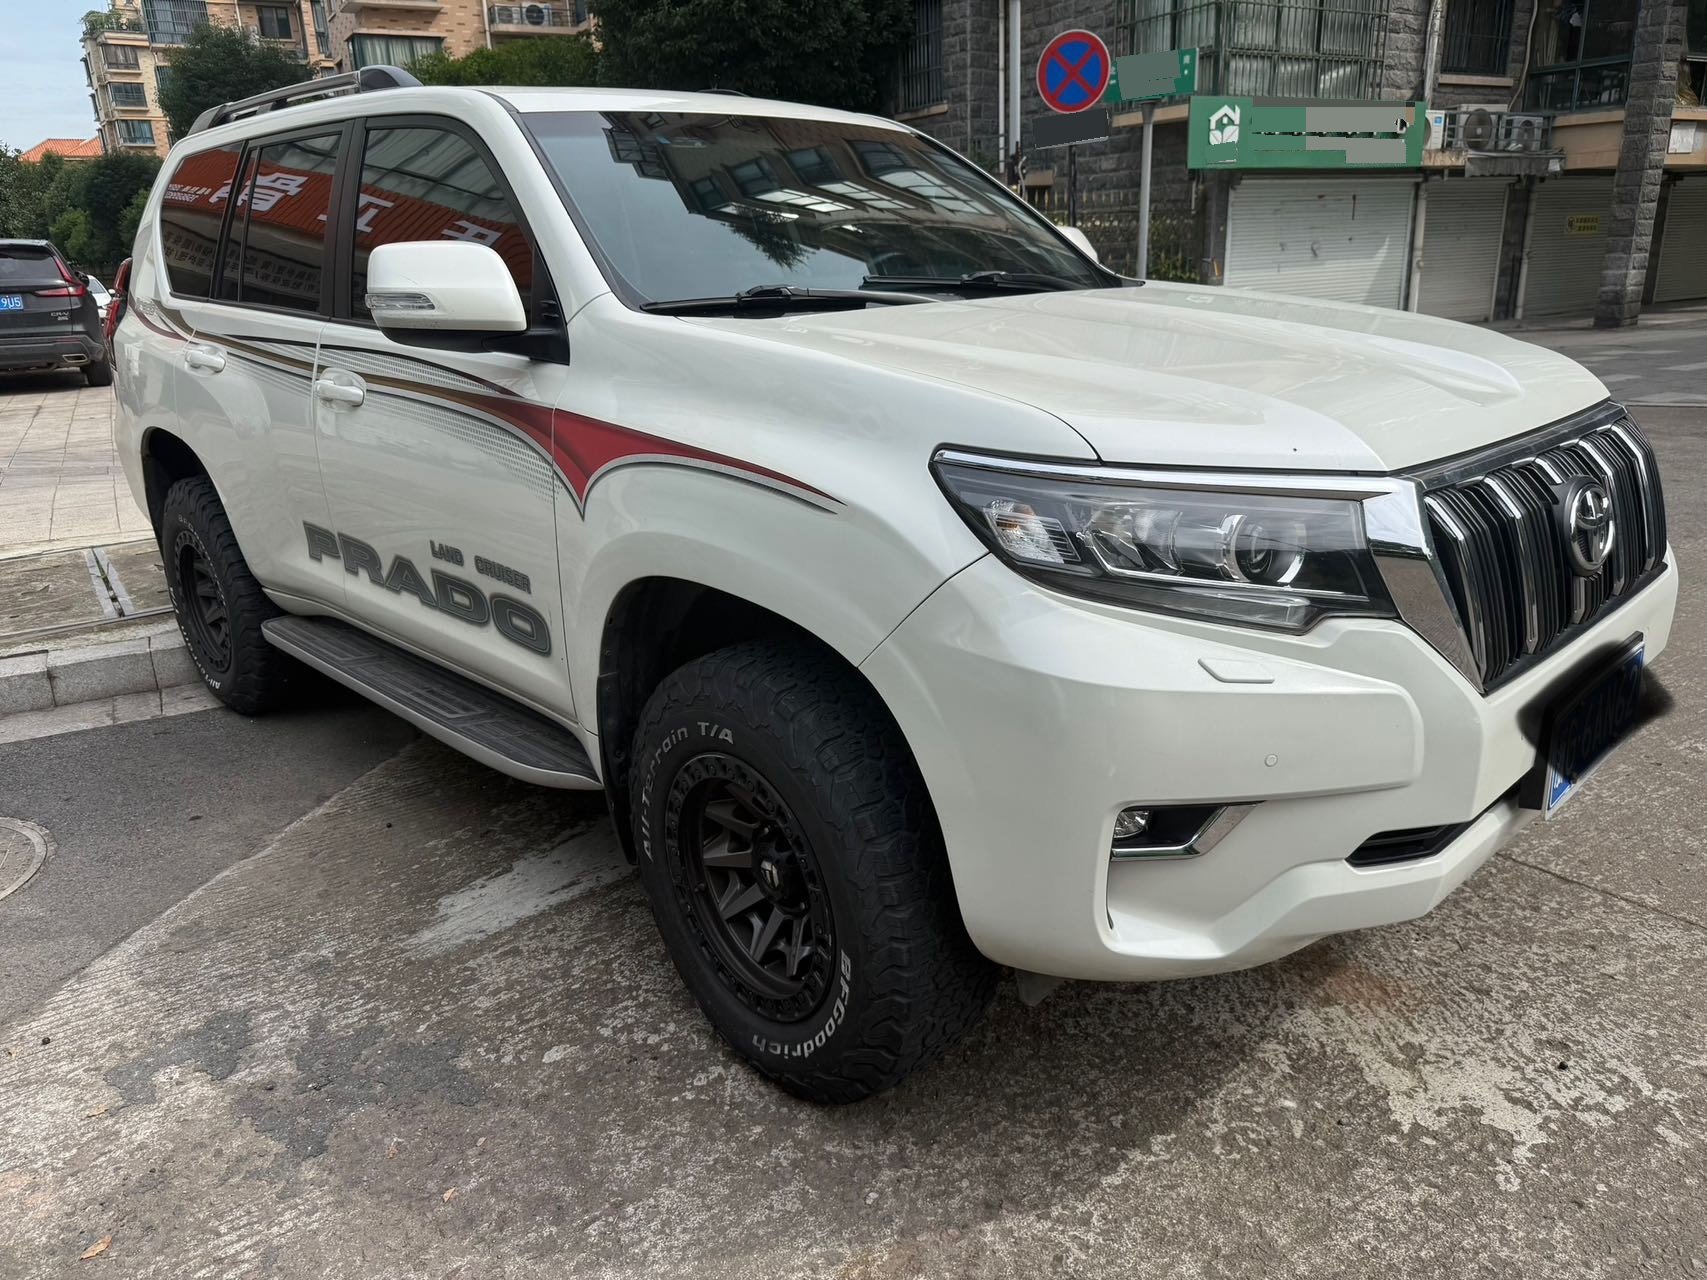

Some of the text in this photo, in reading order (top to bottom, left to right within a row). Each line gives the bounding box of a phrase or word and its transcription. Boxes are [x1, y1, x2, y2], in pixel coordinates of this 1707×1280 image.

[302, 520, 552, 657] PRADO
[430, 539, 532, 595] LAND CRUISER
[697, 721, 734, 745] T/A
[752, 948, 852, 1060] BFGoodrich
